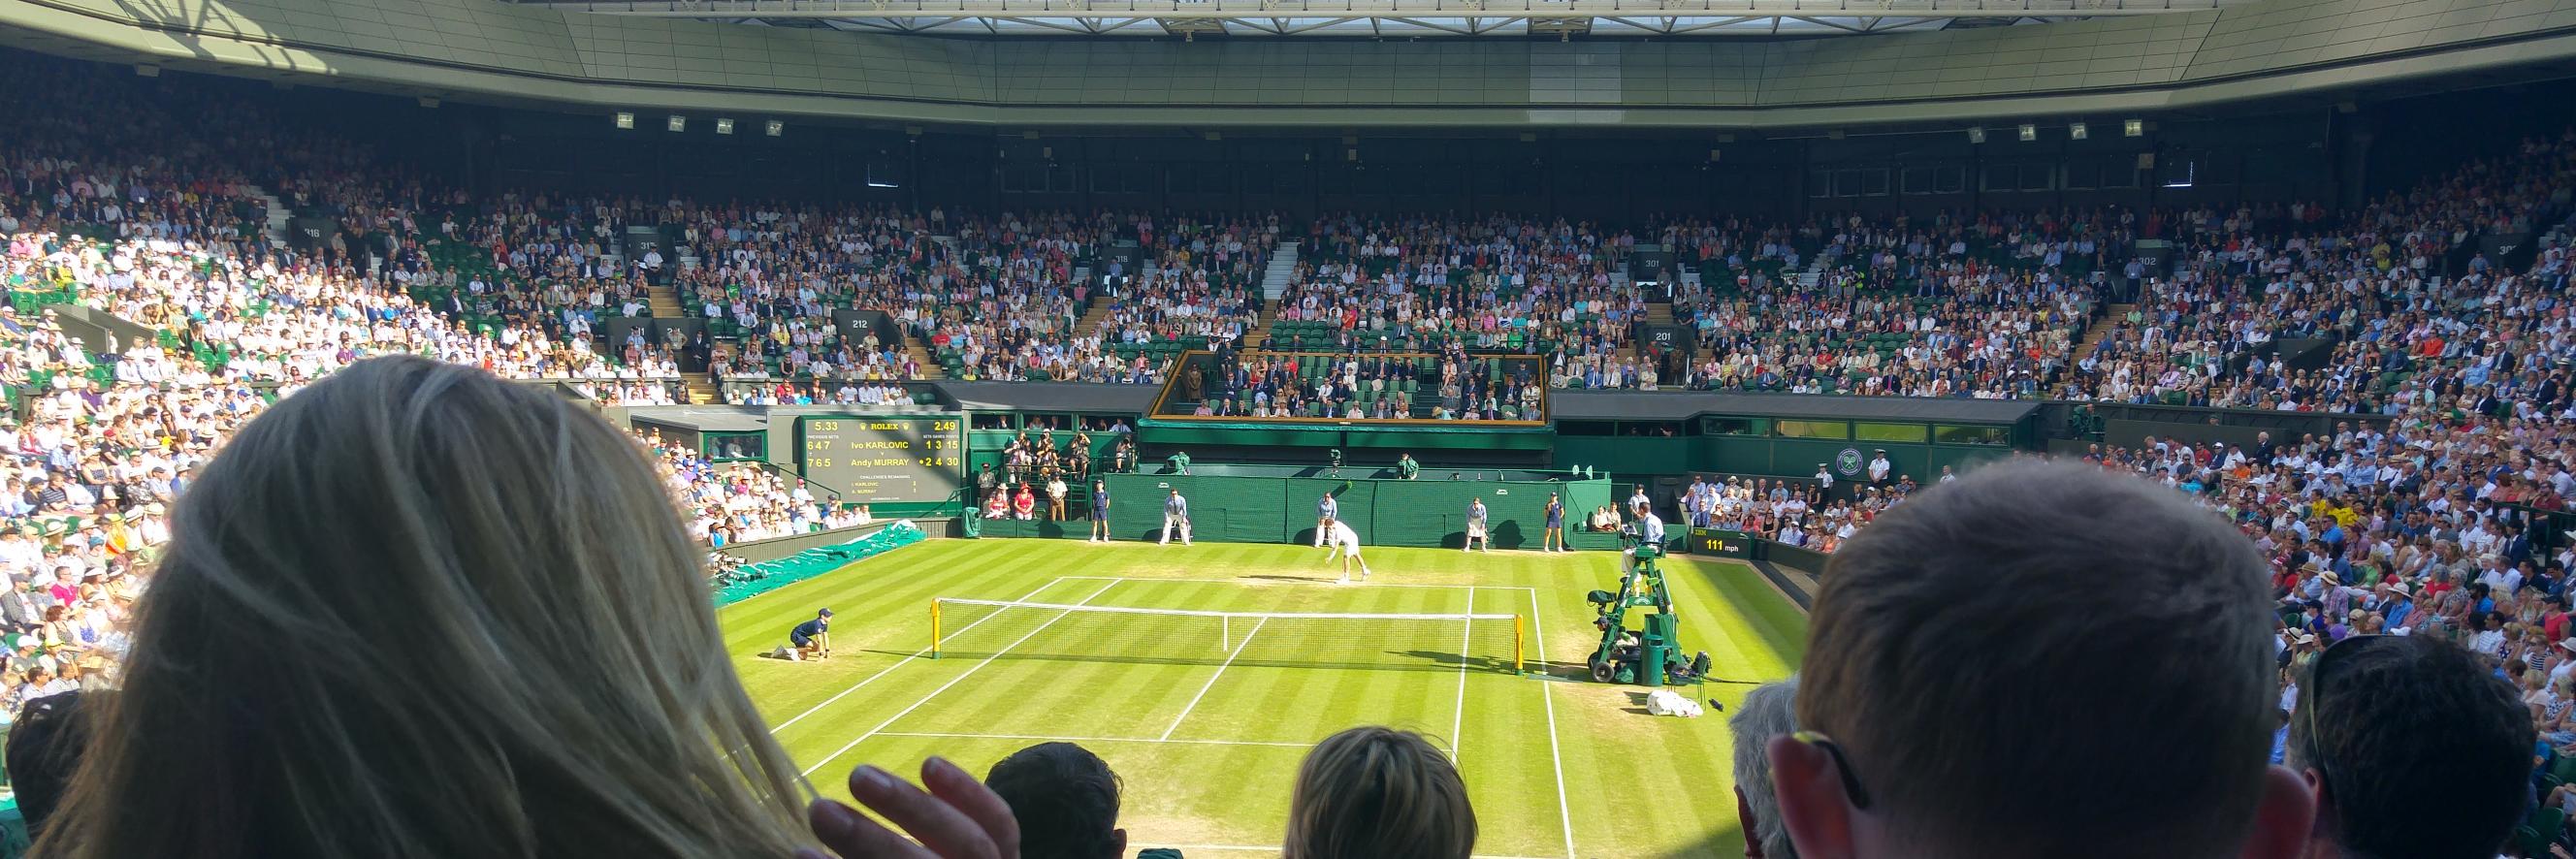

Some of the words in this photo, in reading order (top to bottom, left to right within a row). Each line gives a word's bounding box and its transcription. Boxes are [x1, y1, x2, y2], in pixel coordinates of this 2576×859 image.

[853, 319, 868, 329] 212
[1656, 332, 1671, 341] 201
[815, 421, 838, 431] 5.33
[934, 421, 956, 431] 2.49
[807, 440, 814, 450] 6
[815, 440, 821, 450] 4
[823, 440, 830, 450] 7
[865, 441, 909, 450] KARLOVIC
[925, 440, 932, 450] 1
[935, 440, 942, 450] 3
[946, 440, 958, 450] 15
[807, 458, 814, 467] 7
[816, 458, 822, 467] 6
[824, 458, 831, 467] 5
[925, 457, 932, 466] 2
[935, 457, 943, 466] 4
[947, 457, 959, 466] 30
[1706, 539, 1723, 551] 111
